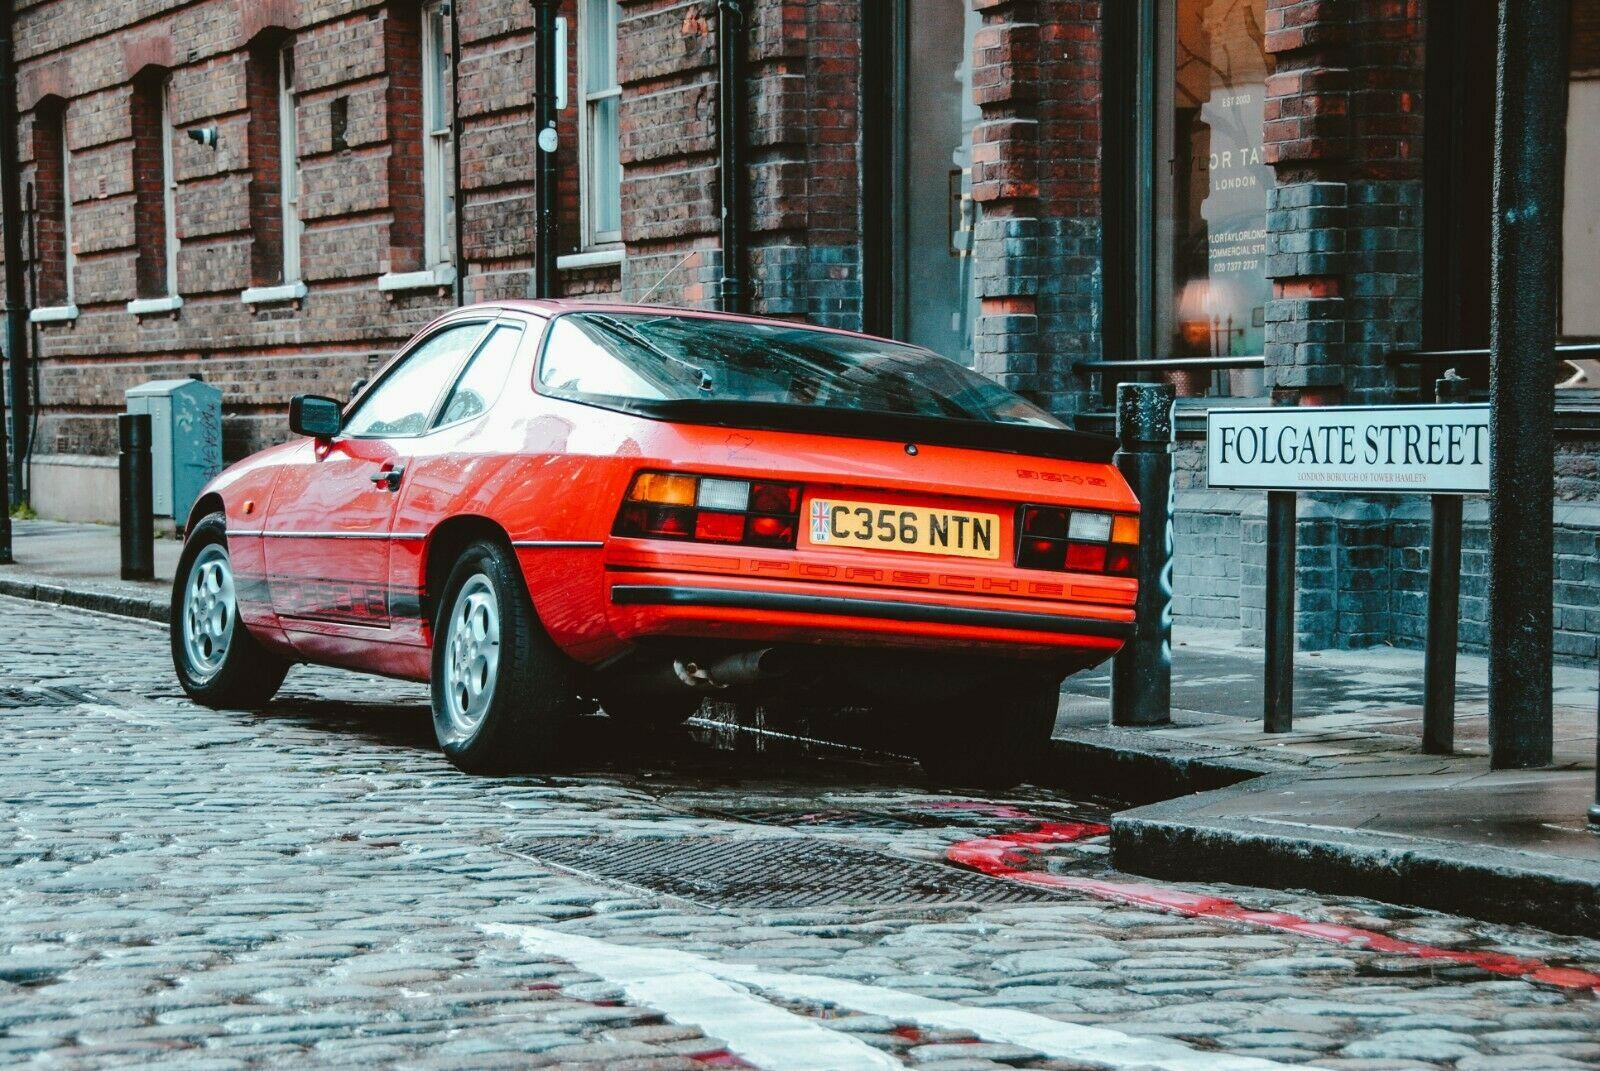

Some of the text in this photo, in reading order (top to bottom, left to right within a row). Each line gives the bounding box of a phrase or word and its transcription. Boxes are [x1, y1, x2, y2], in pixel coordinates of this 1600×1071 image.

[1222, 97, 1234, 107] EST
[1240, 147, 1265, 167] TA
[1215, 176, 1256, 190] LONDON
[1214, 263, 1226, 273] 020
[1228, 262, 1241, 272] 7377
[1219, 424, 1489, 465] FOLGATE STREET
[1298, 472, 1427, 483] LONDON BOROUGH OF TOWER HAMLETS
[831, 505, 992, 551] C356 NTN
[816, 533, 826, 541] UK
[750, 559, 1064, 596] PORSCHE
